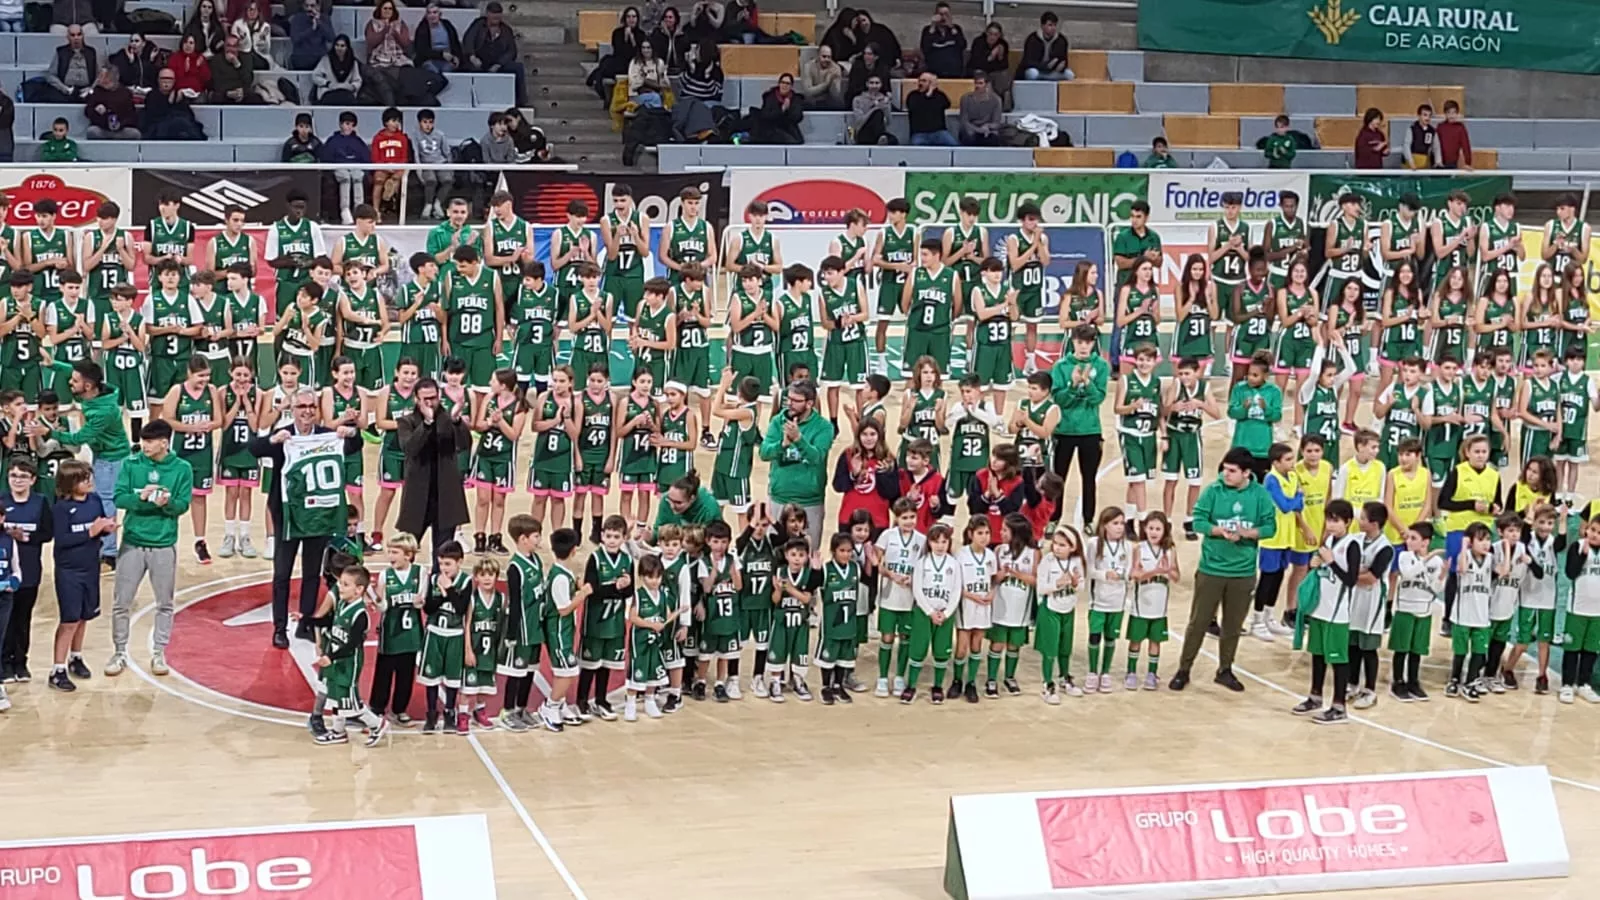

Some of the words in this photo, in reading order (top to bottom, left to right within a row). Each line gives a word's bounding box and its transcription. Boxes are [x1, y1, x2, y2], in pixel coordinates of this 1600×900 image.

[1369, 5, 1431, 27] CAJA
[1438, 8, 1520, 32] RURAL
[1385, 32, 1411, 48] DE
[1417, 33, 1501, 52] ARAGÓN
[30, 180, 57, 189] 1876
[1166, 182, 1282, 208] Fontebra
[618, 250, 634, 269] 17
[1223, 256, 1240, 274] 14
[1497, 254, 1515, 272] 20
[101, 269, 118, 288] 13
[460, 313, 482, 334] 88
[923, 305, 936, 325] 8
[532, 325, 544, 344] 3
[988, 322, 1008, 341] 33
[1135, 320, 1151, 336] 33
[1189, 319, 1206, 336] 31
[167, 335, 178, 354] 3
[681, 329, 701, 348] 20
[18, 339, 30, 359] 5
[65, 345, 84, 361] 12
[233, 425, 249, 442] 13
[483, 432, 503, 451] 34
[548, 435, 558, 451] 8
[634, 434, 649, 451] 14
[962, 438, 982, 456] 32
[301, 459, 341, 492] 10
[1187, 468, 1199, 478] 57
[751, 576, 767, 595] 17
[601, 600, 622, 620] 77
[717, 598, 732, 616] 13
[842, 605, 849, 624] 1
[402, 610, 413, 629] 6
[785, 612, 802, 628] 10
[482, 636, 491, 655] 9
[1136, 810, 1198, 829] GRUPO
[1240, 849, 1275, 866] HIGH
[1281, 846, 1340, 864] QUALITY
[1347, 841, 1396, 859] HOMES
